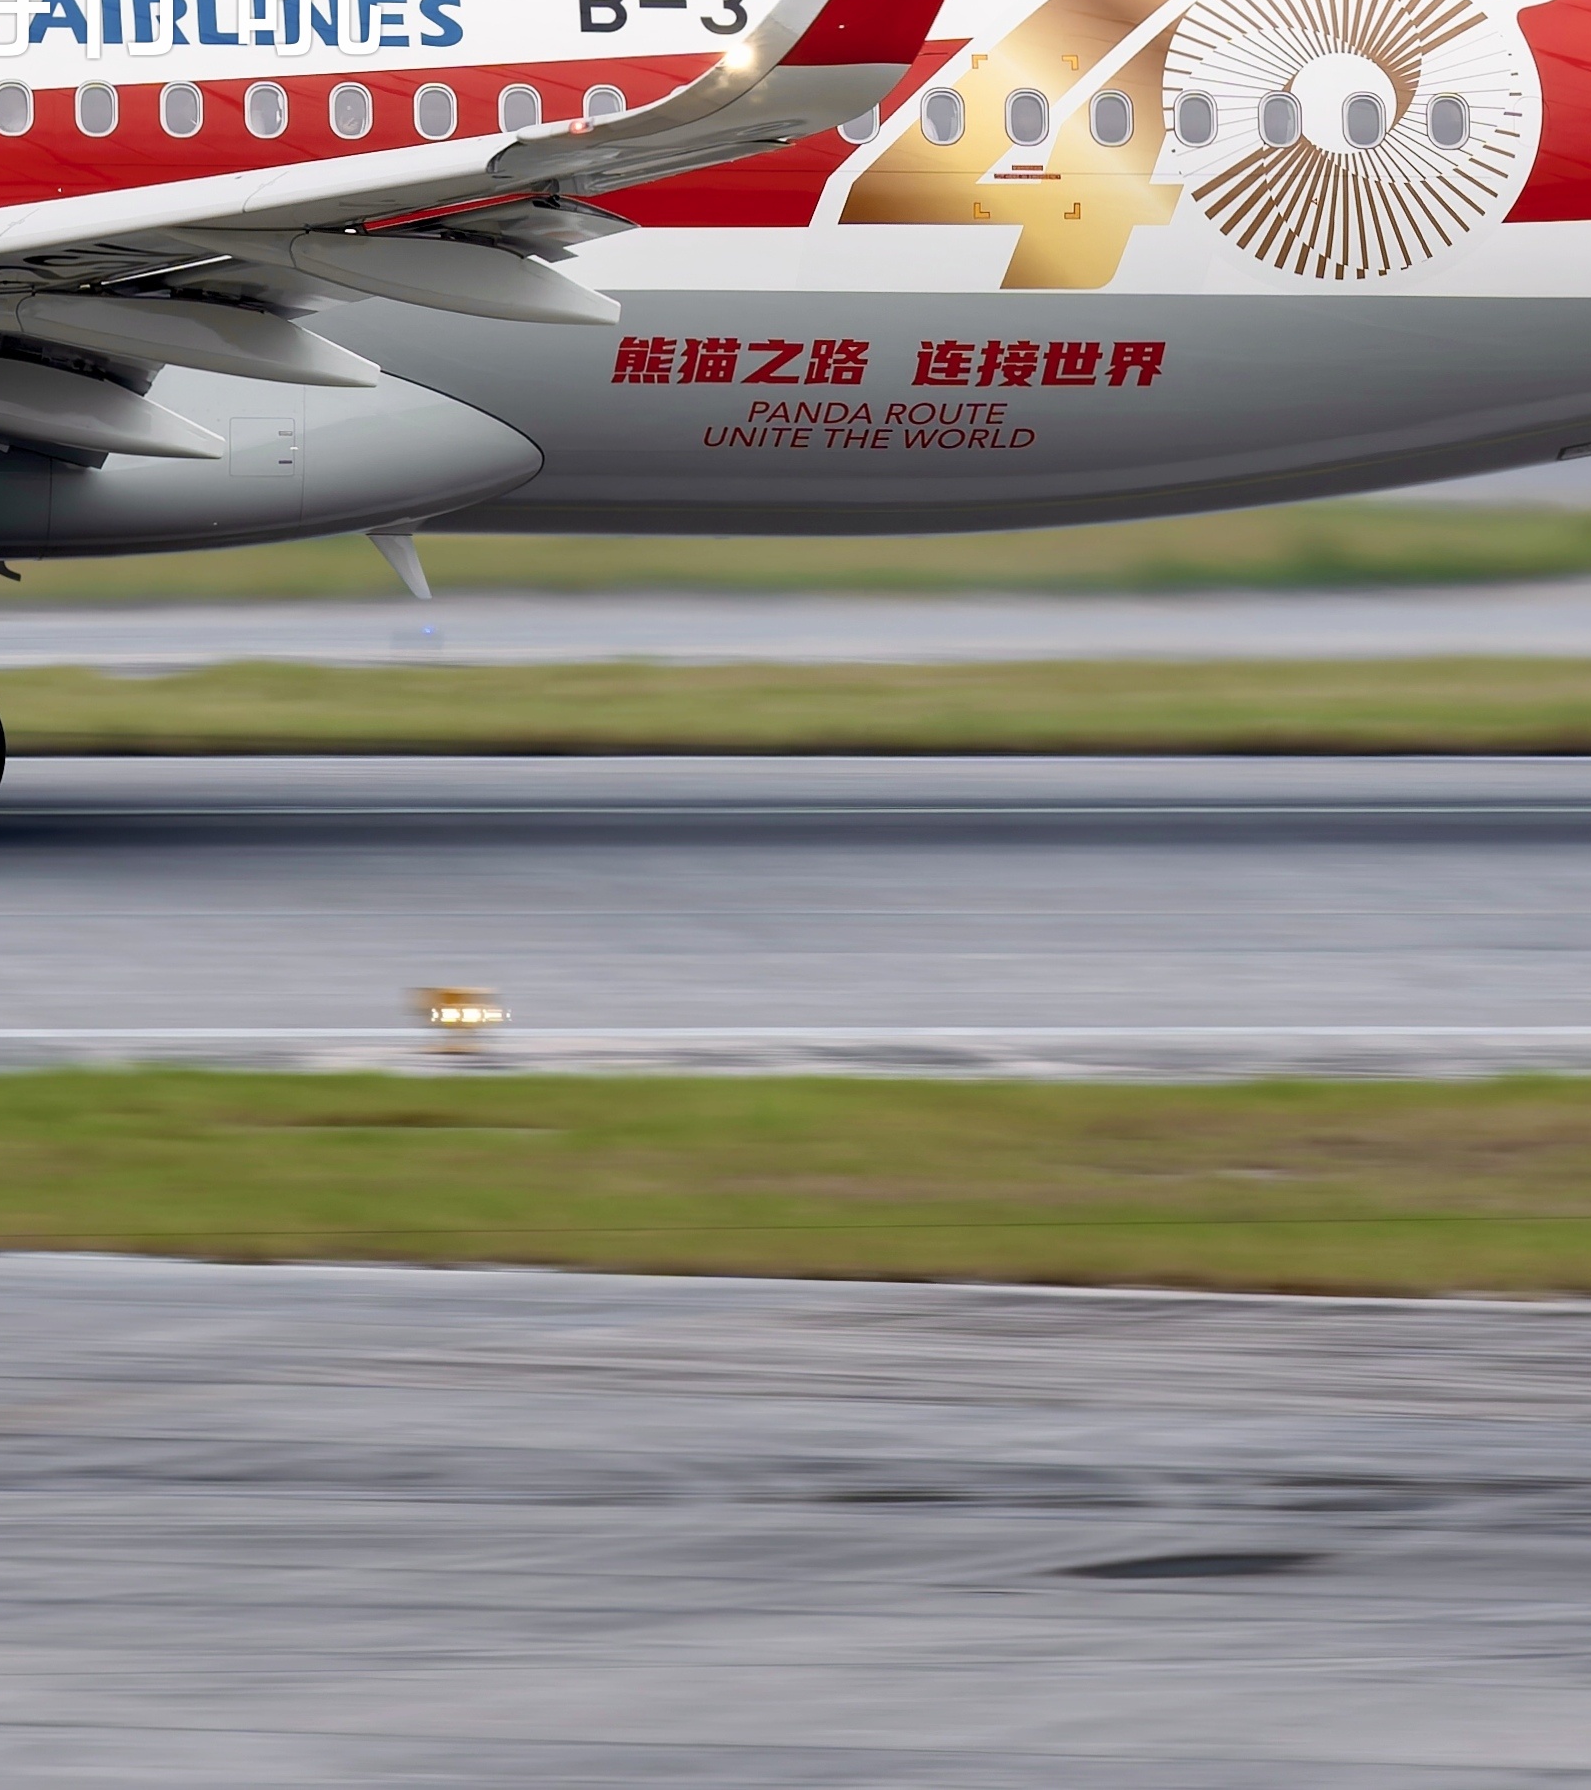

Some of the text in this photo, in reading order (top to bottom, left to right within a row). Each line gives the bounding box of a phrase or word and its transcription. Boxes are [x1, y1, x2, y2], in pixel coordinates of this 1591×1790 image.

[611, 336, 1166, 387] 熊猫之路 连接世界
[747, 401, 1008, 426] PANDA ROUTE
[703, 427, 1036, 449] UNITE THE WORLD
